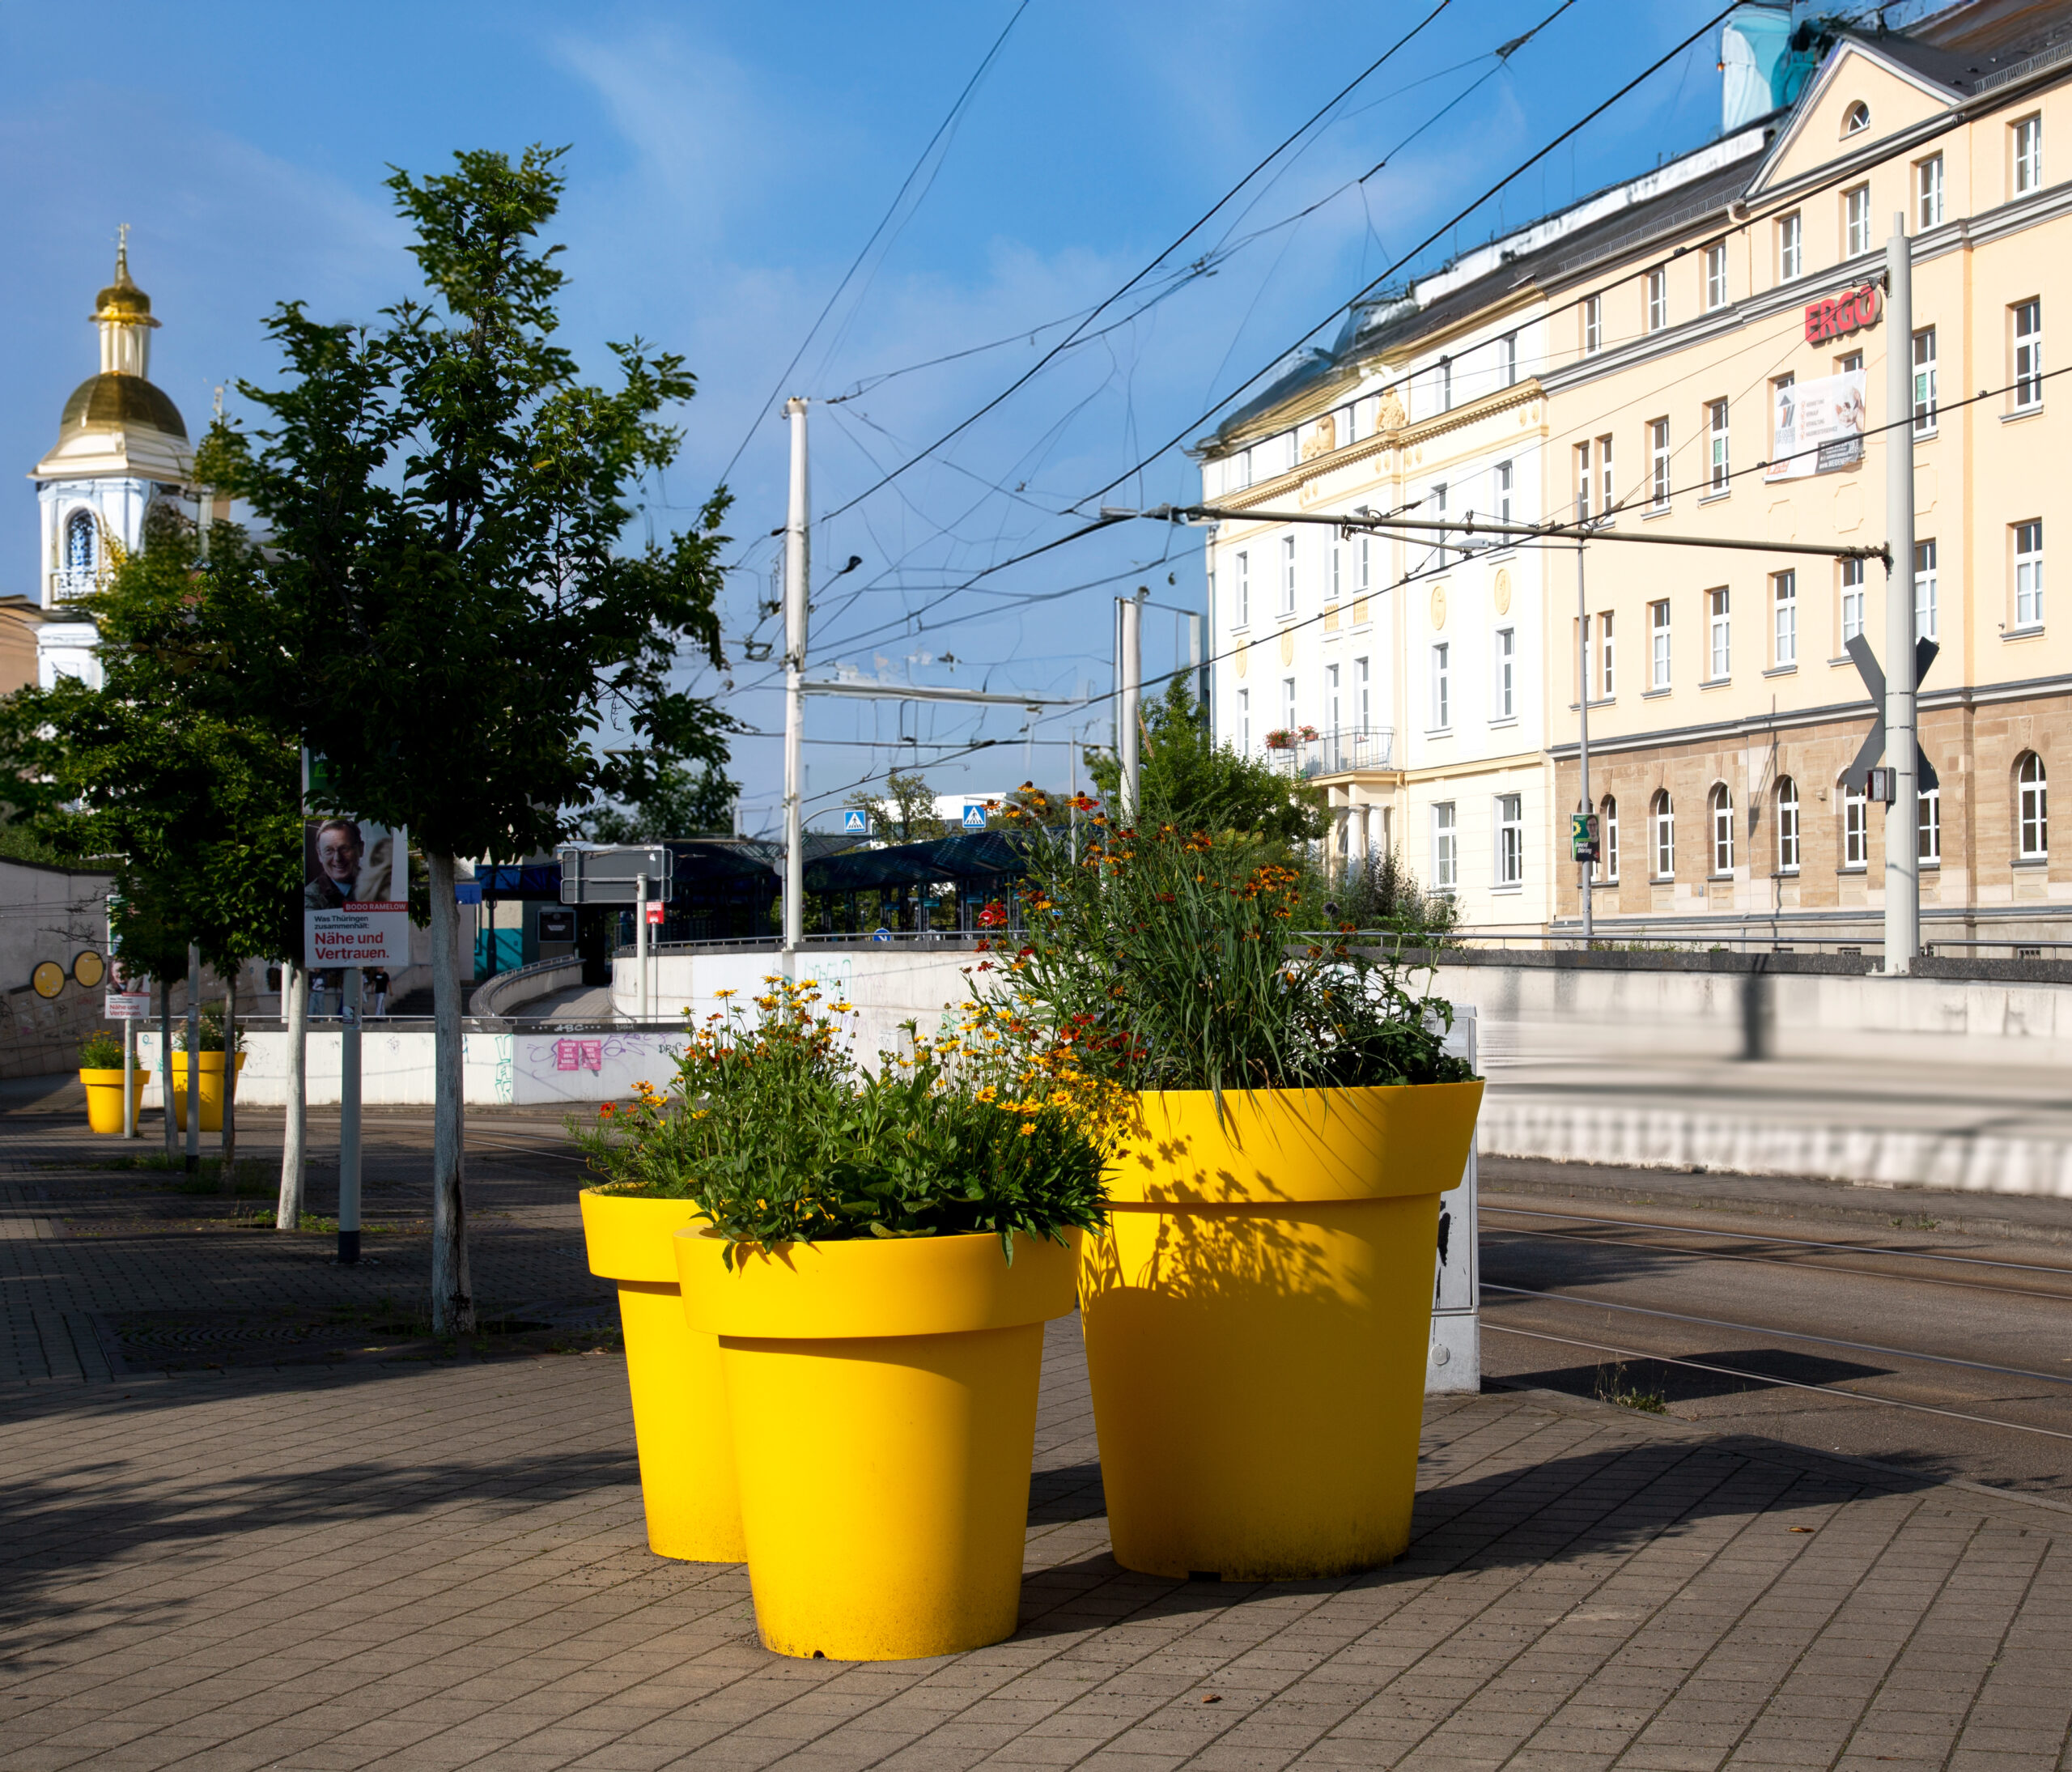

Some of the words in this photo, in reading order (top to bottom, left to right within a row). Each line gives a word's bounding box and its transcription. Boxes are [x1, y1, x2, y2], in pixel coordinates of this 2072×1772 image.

[1805, 284, 1878, 344] ERGO
[332, 915, 369, 923] Thüringen
[314, 932, 355, 945] Nähe
[358, 932, 384, 944] und
[314, 947, 389, 960] Vertrauen.
